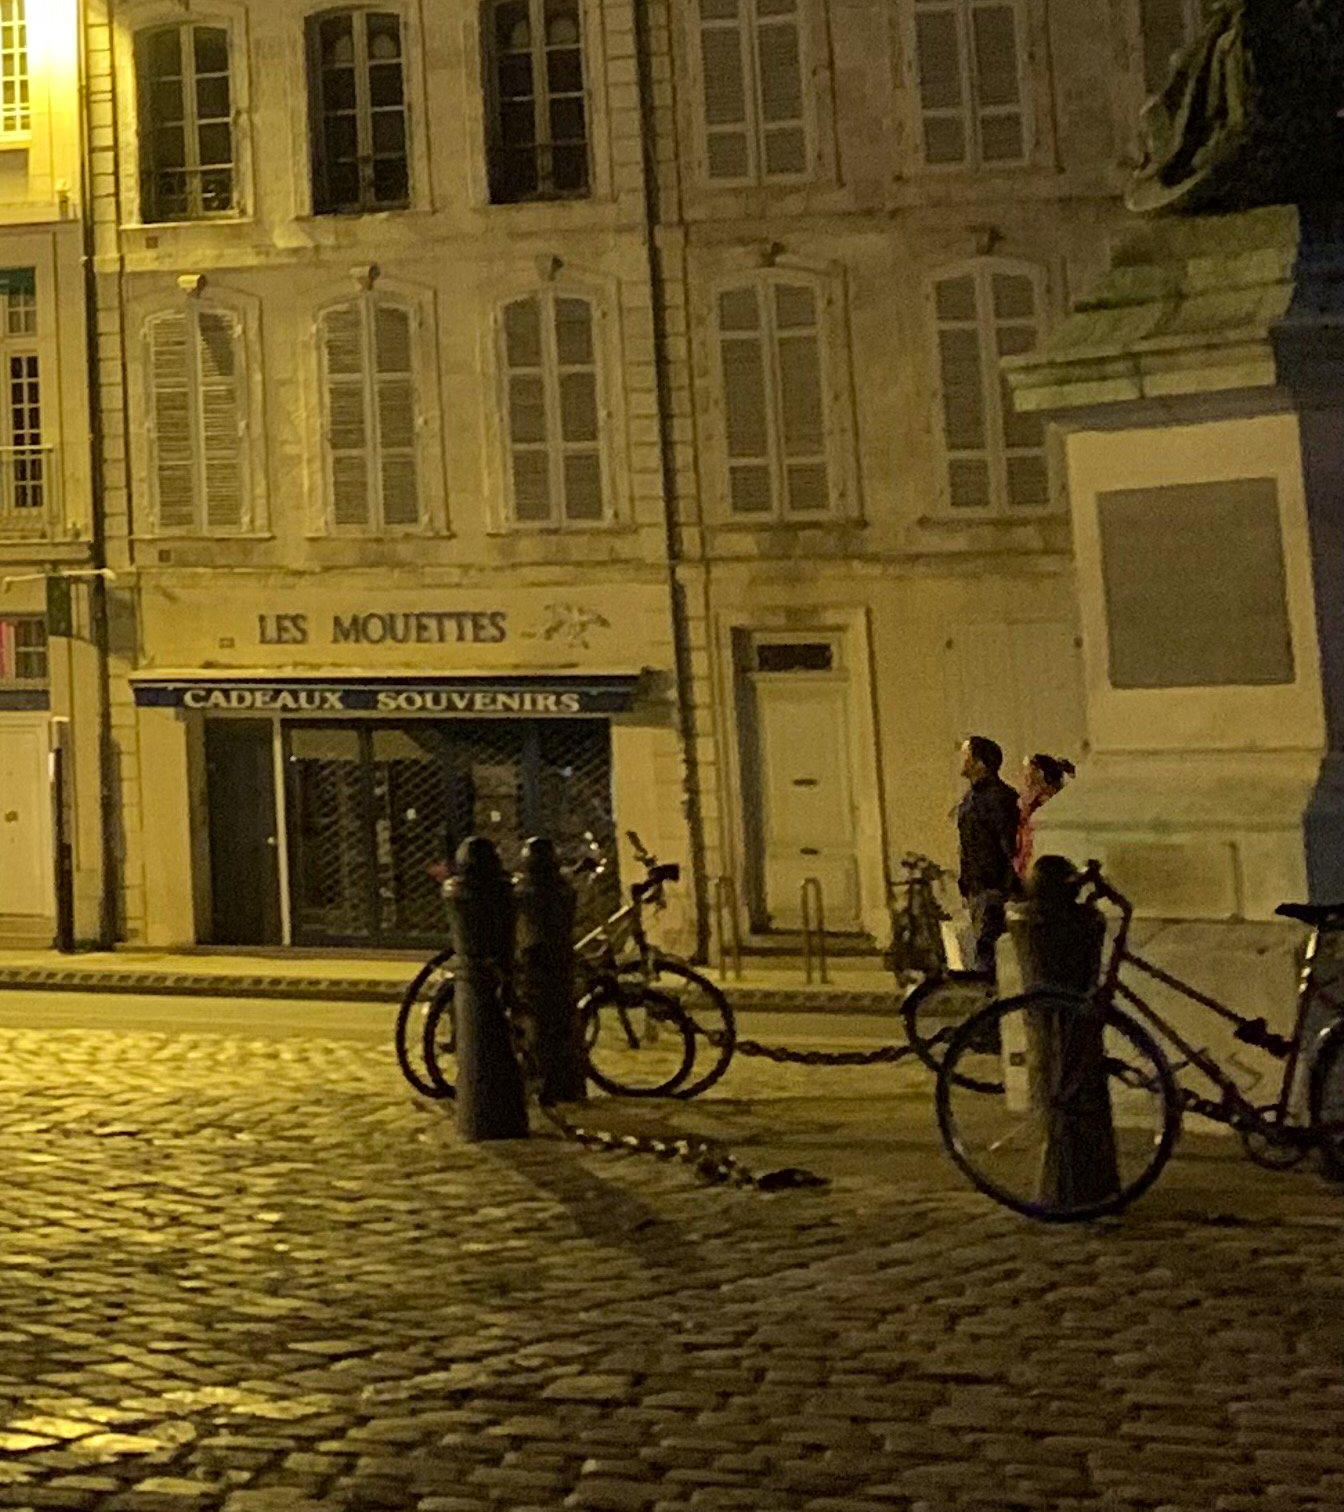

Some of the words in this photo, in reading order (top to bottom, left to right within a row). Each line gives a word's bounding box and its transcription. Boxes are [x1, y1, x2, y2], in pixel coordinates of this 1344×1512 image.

[258, 613, 309, 645] LES
[331, 610, 508, 645] MOUETTES
[183, 689, 344, 710] CADEAUX
[376, 691, 581, 713] SOUVENIRS
